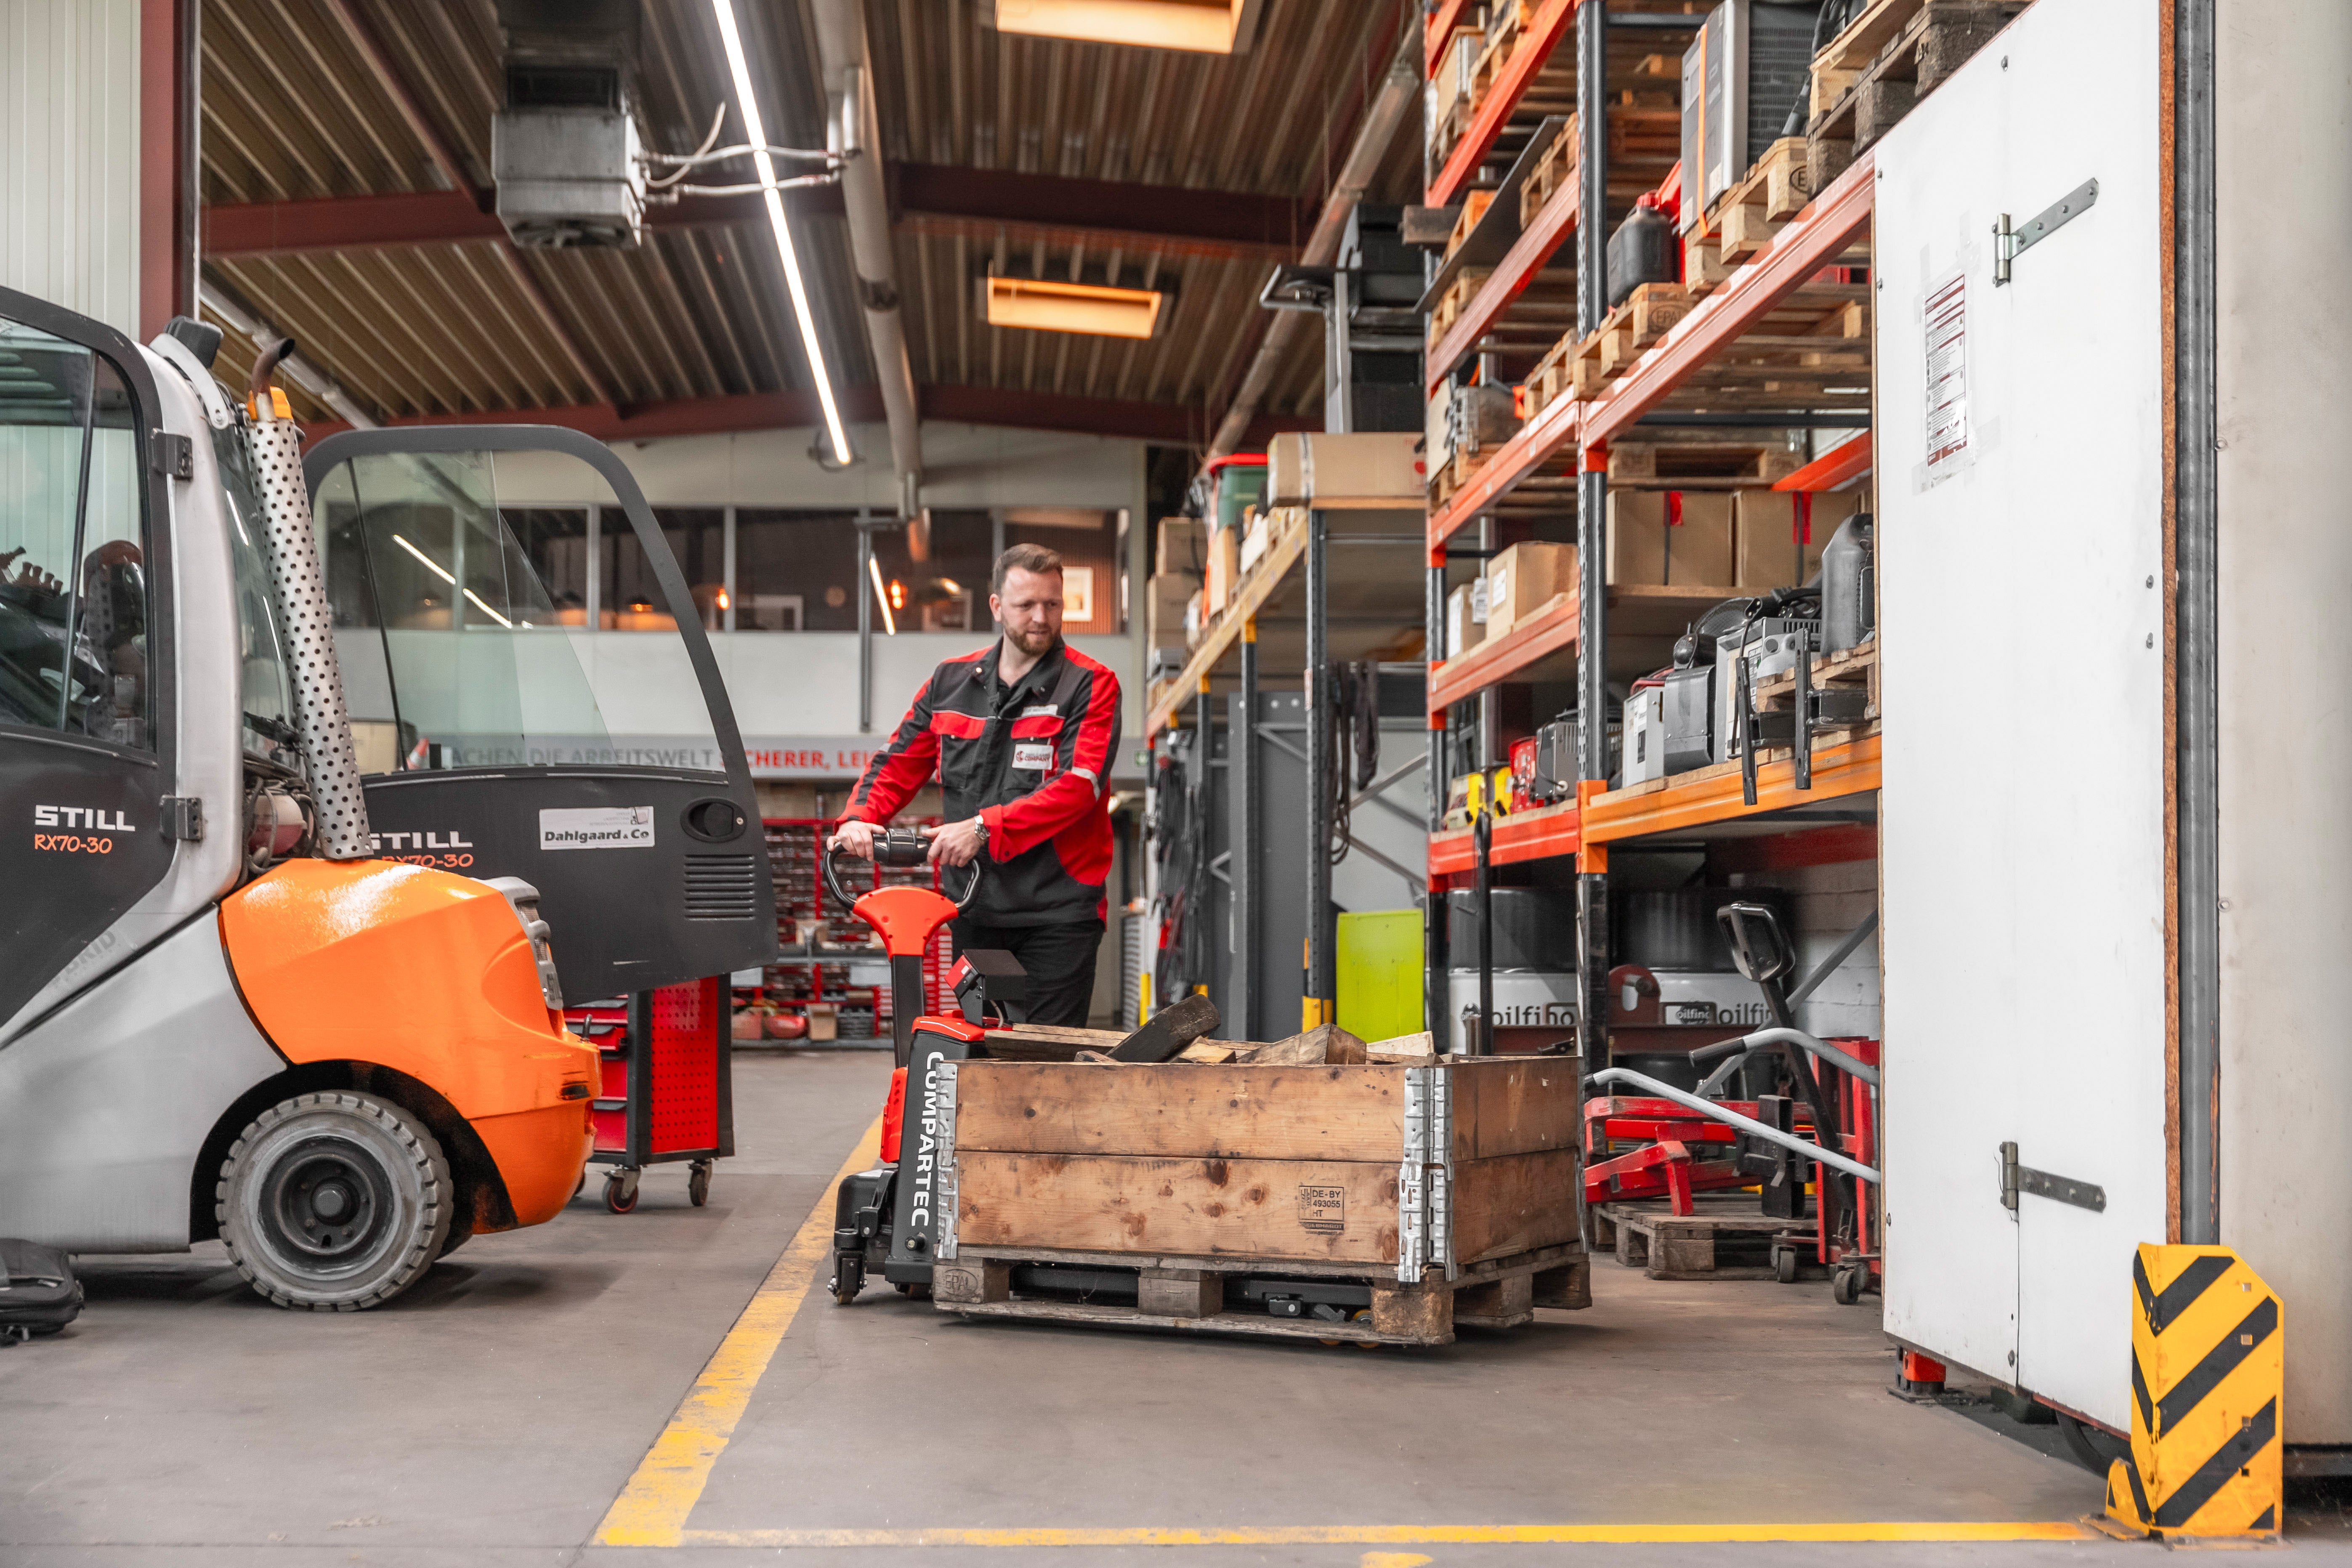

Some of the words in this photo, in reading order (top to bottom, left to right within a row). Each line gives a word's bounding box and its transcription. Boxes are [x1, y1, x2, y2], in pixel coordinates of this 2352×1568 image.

[571, 748, 714, 766] ARBEITSWELT
[837, 750, 874, 768] LEI
[35, 805, 135, 832] STILL
[35, 834, 112, 854] RX70-30
[545, 830, 622, 843] Dahlgaard
[631, 829, 649, 839] Co
[911, 1051, 944, 1227] COMPARTEC
